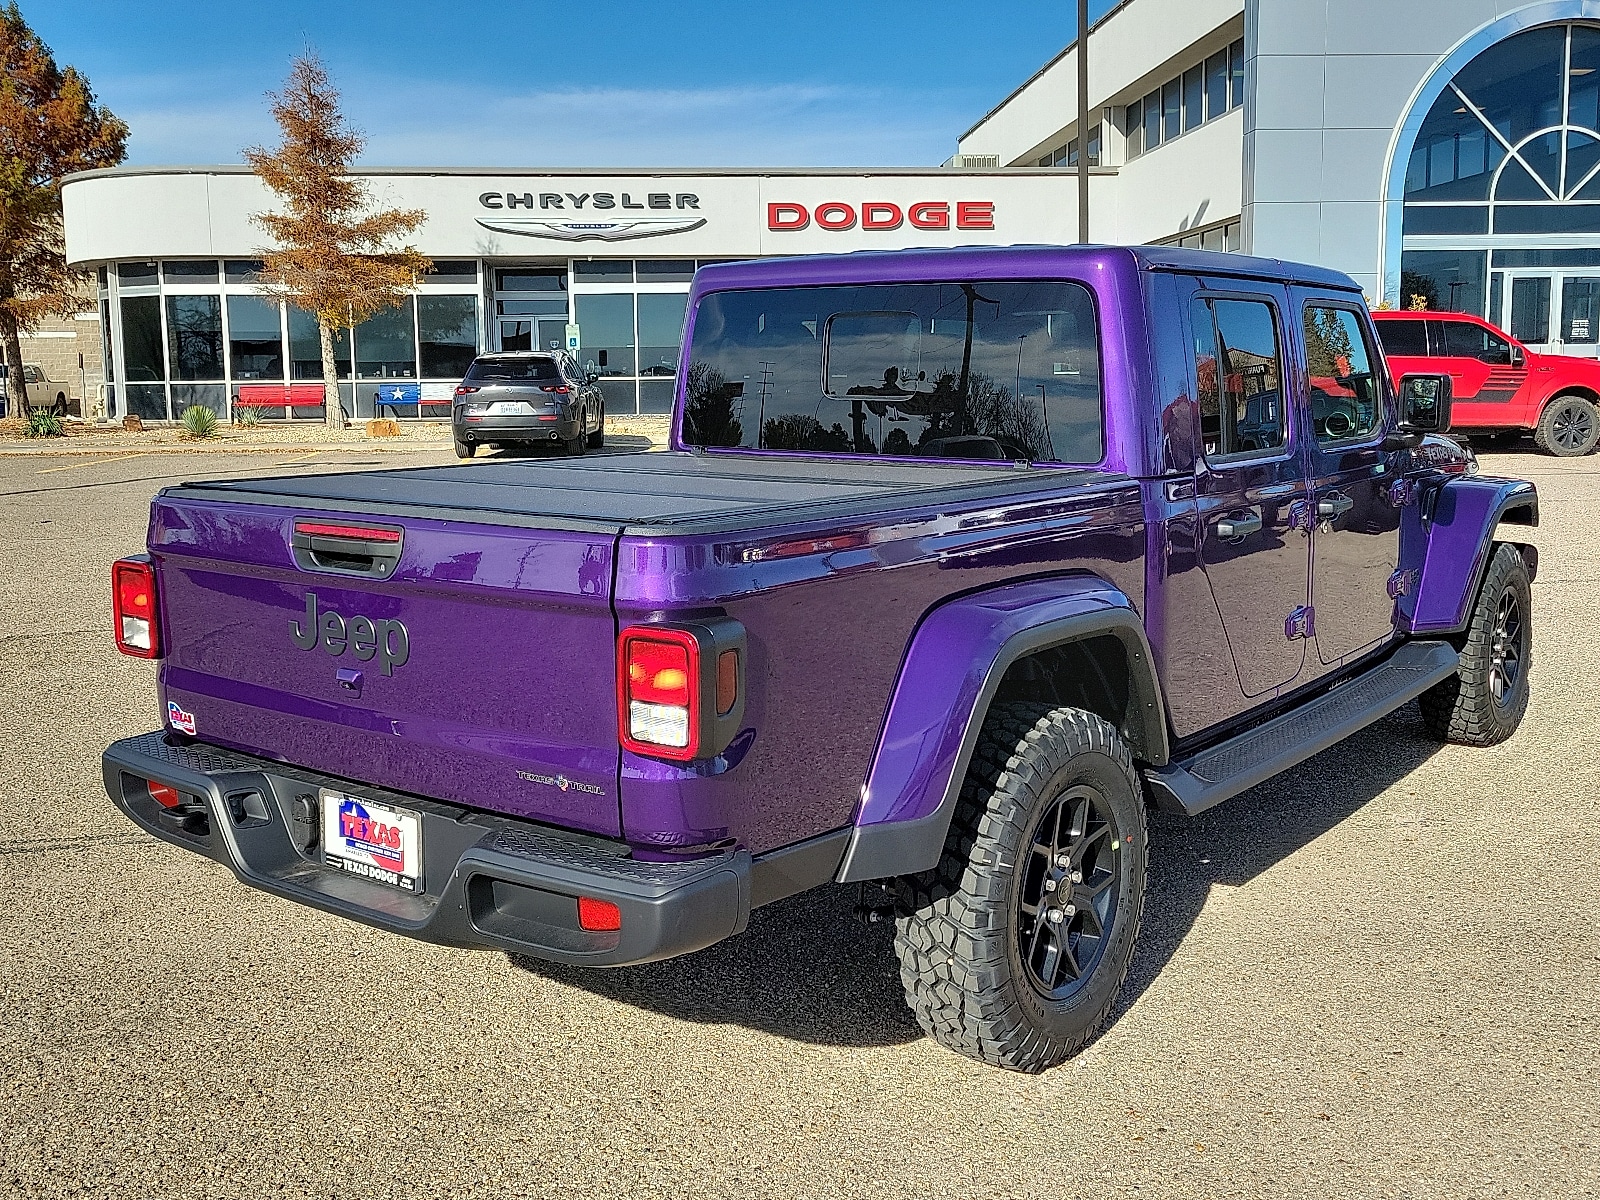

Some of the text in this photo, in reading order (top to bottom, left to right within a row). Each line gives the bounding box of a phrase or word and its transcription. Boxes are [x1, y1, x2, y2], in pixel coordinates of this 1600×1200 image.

[478, 192, 701, 209] CHRYSLER
[767, 201, 995, 231] DODGE
[288, 592, 410, 677] Jeep
[516, 770, 605, 796] TEXAS TRAIL
[341, 812, 401, 850] TEXAS
[343, 858, 368, 876] TEXAS
[369, 866, 398, 885] DODGE
